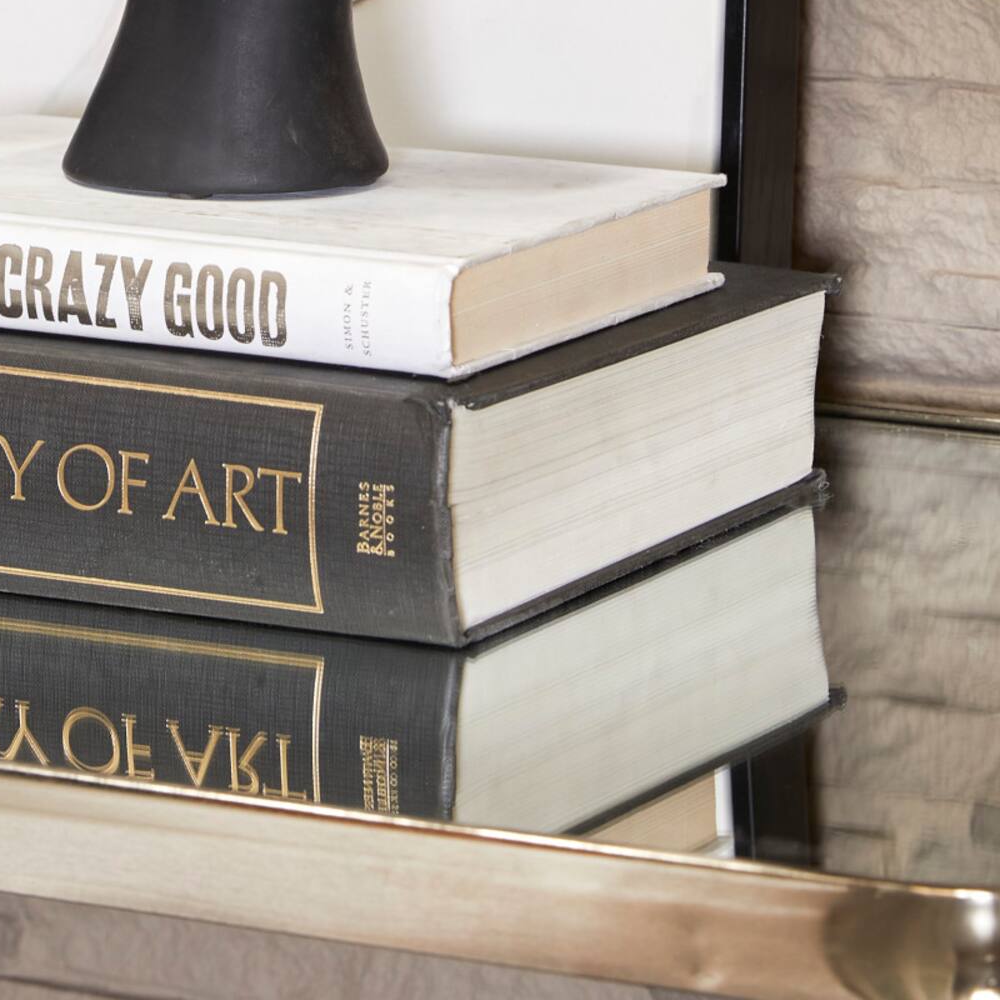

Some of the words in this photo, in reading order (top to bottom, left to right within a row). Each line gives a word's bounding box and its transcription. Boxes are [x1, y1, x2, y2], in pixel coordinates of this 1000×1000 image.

[164, 261, 287, 347] GOOD
[344, 283, 353, 296] &
[361, 281, 372, 357] SCHUSTER
[343, 303, 353, 352] SIMON
[56, 443, 150, 515] OF
[162, 458, 303, 535] ART
[357, 482, 370, 554] BARNES
